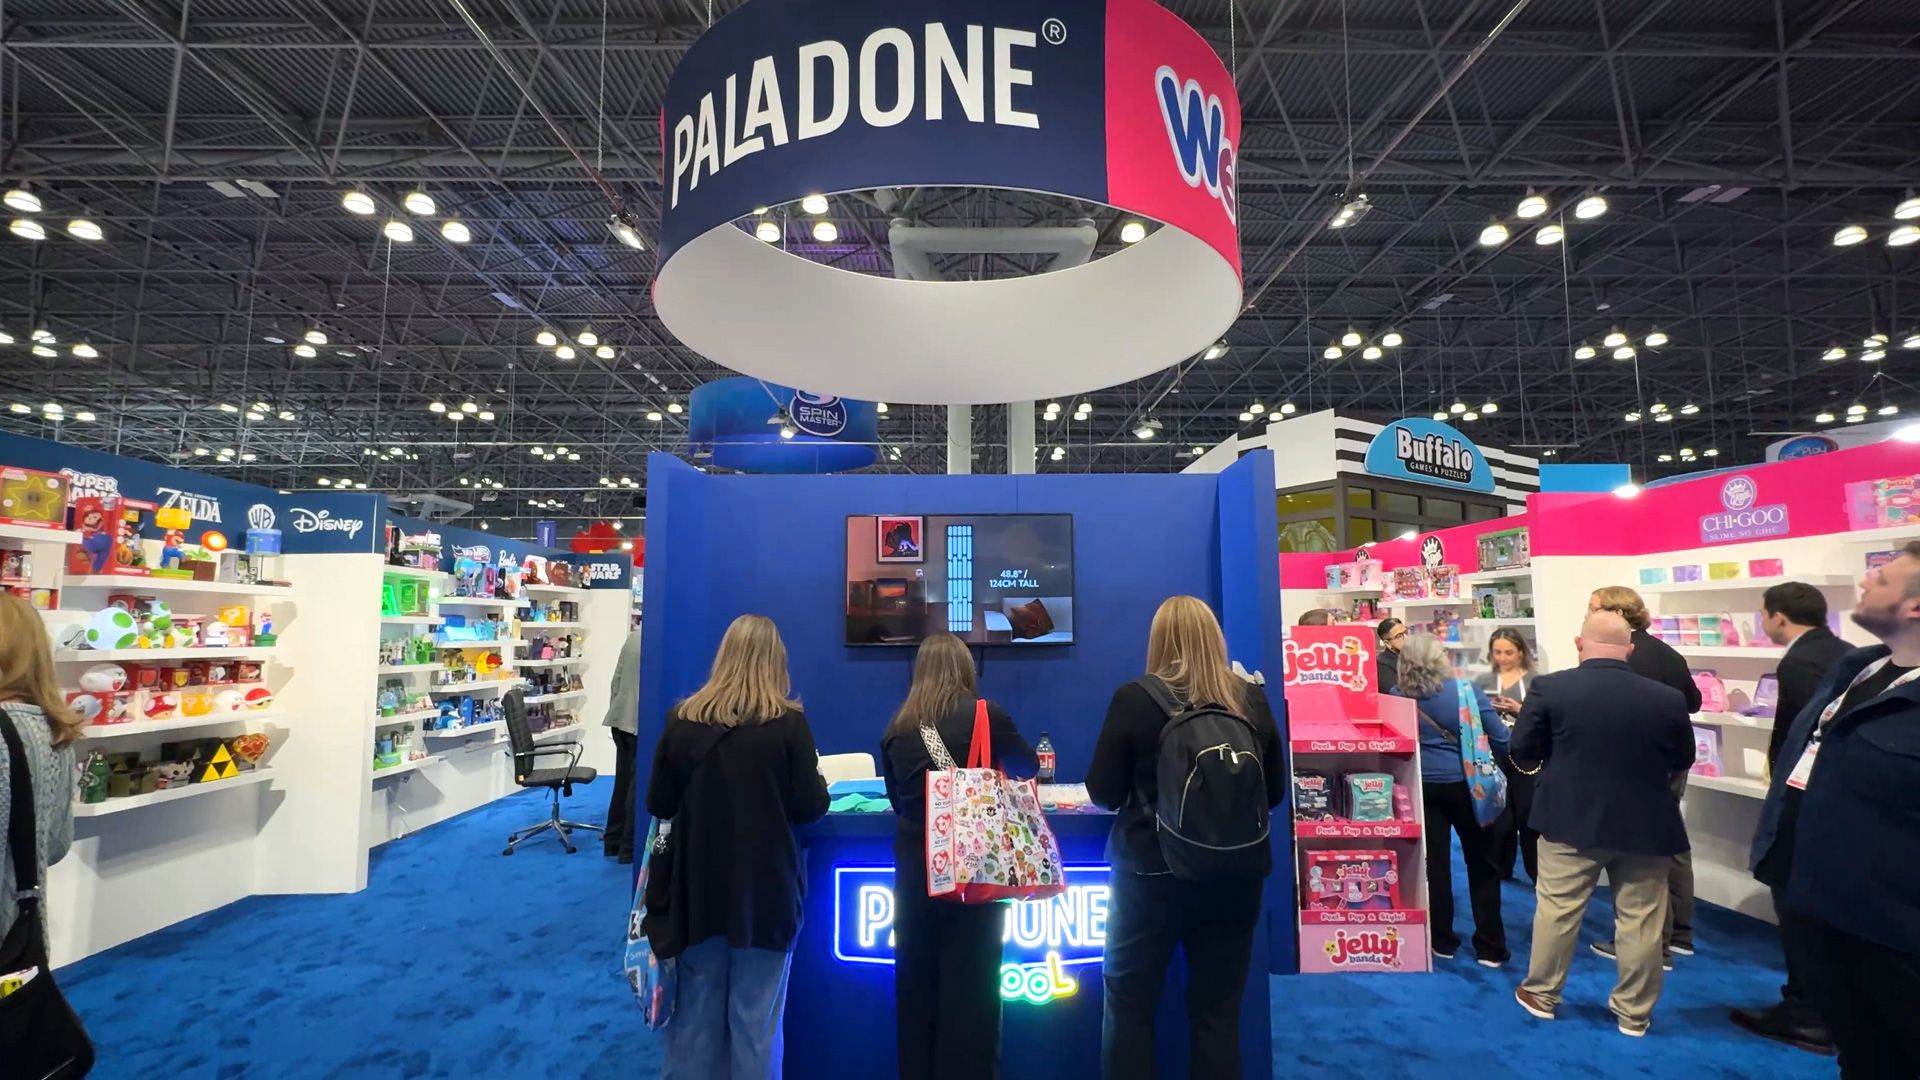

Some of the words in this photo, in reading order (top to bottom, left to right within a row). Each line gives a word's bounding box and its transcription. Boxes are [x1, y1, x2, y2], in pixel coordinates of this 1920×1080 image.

[799, 406, 838, 420] SPIN
[1396, 427, 1473, 471] Buffalo
[1410, 461, 1433, 473] GAMES
[1434, 467, 1439, 475] &
[1440, 467, 1468, 480] PUZZLES
[156, 487, 222, 523] ZELDA
[1709, 532, 1735, 540] SLIME
[1755, 527, 1778, 535] CHIC
[590, 563, 621, 571] STAR
[590, 571, 621, 580] WARS
[989, 579, 1016, 588] 124CM
[1018, 579, 1039, 588] TALL
[1284, 644, 1360, 683] jelly
[1300, 671, 1339, 682] bands
[1338, 742, 1356, 752] Pop
[1357, 742, 1367, 750] &
[1368, 741, 1396, 752] Style!
[1343, 827, 1361, 837] Pop
[1362, 827, 1371, 835] &
[1373, 826, 1401, 836] Style!
[1341, 864, 1368, 878] jelly
[1348, 913, 1366, 923] Pop
[1367, 913, 1377, 921] &
[1378, 912, 1406, 923] Style!
[1332, 931, 1399, 964] jelly
[1349, 952, 1381, 963] bands
